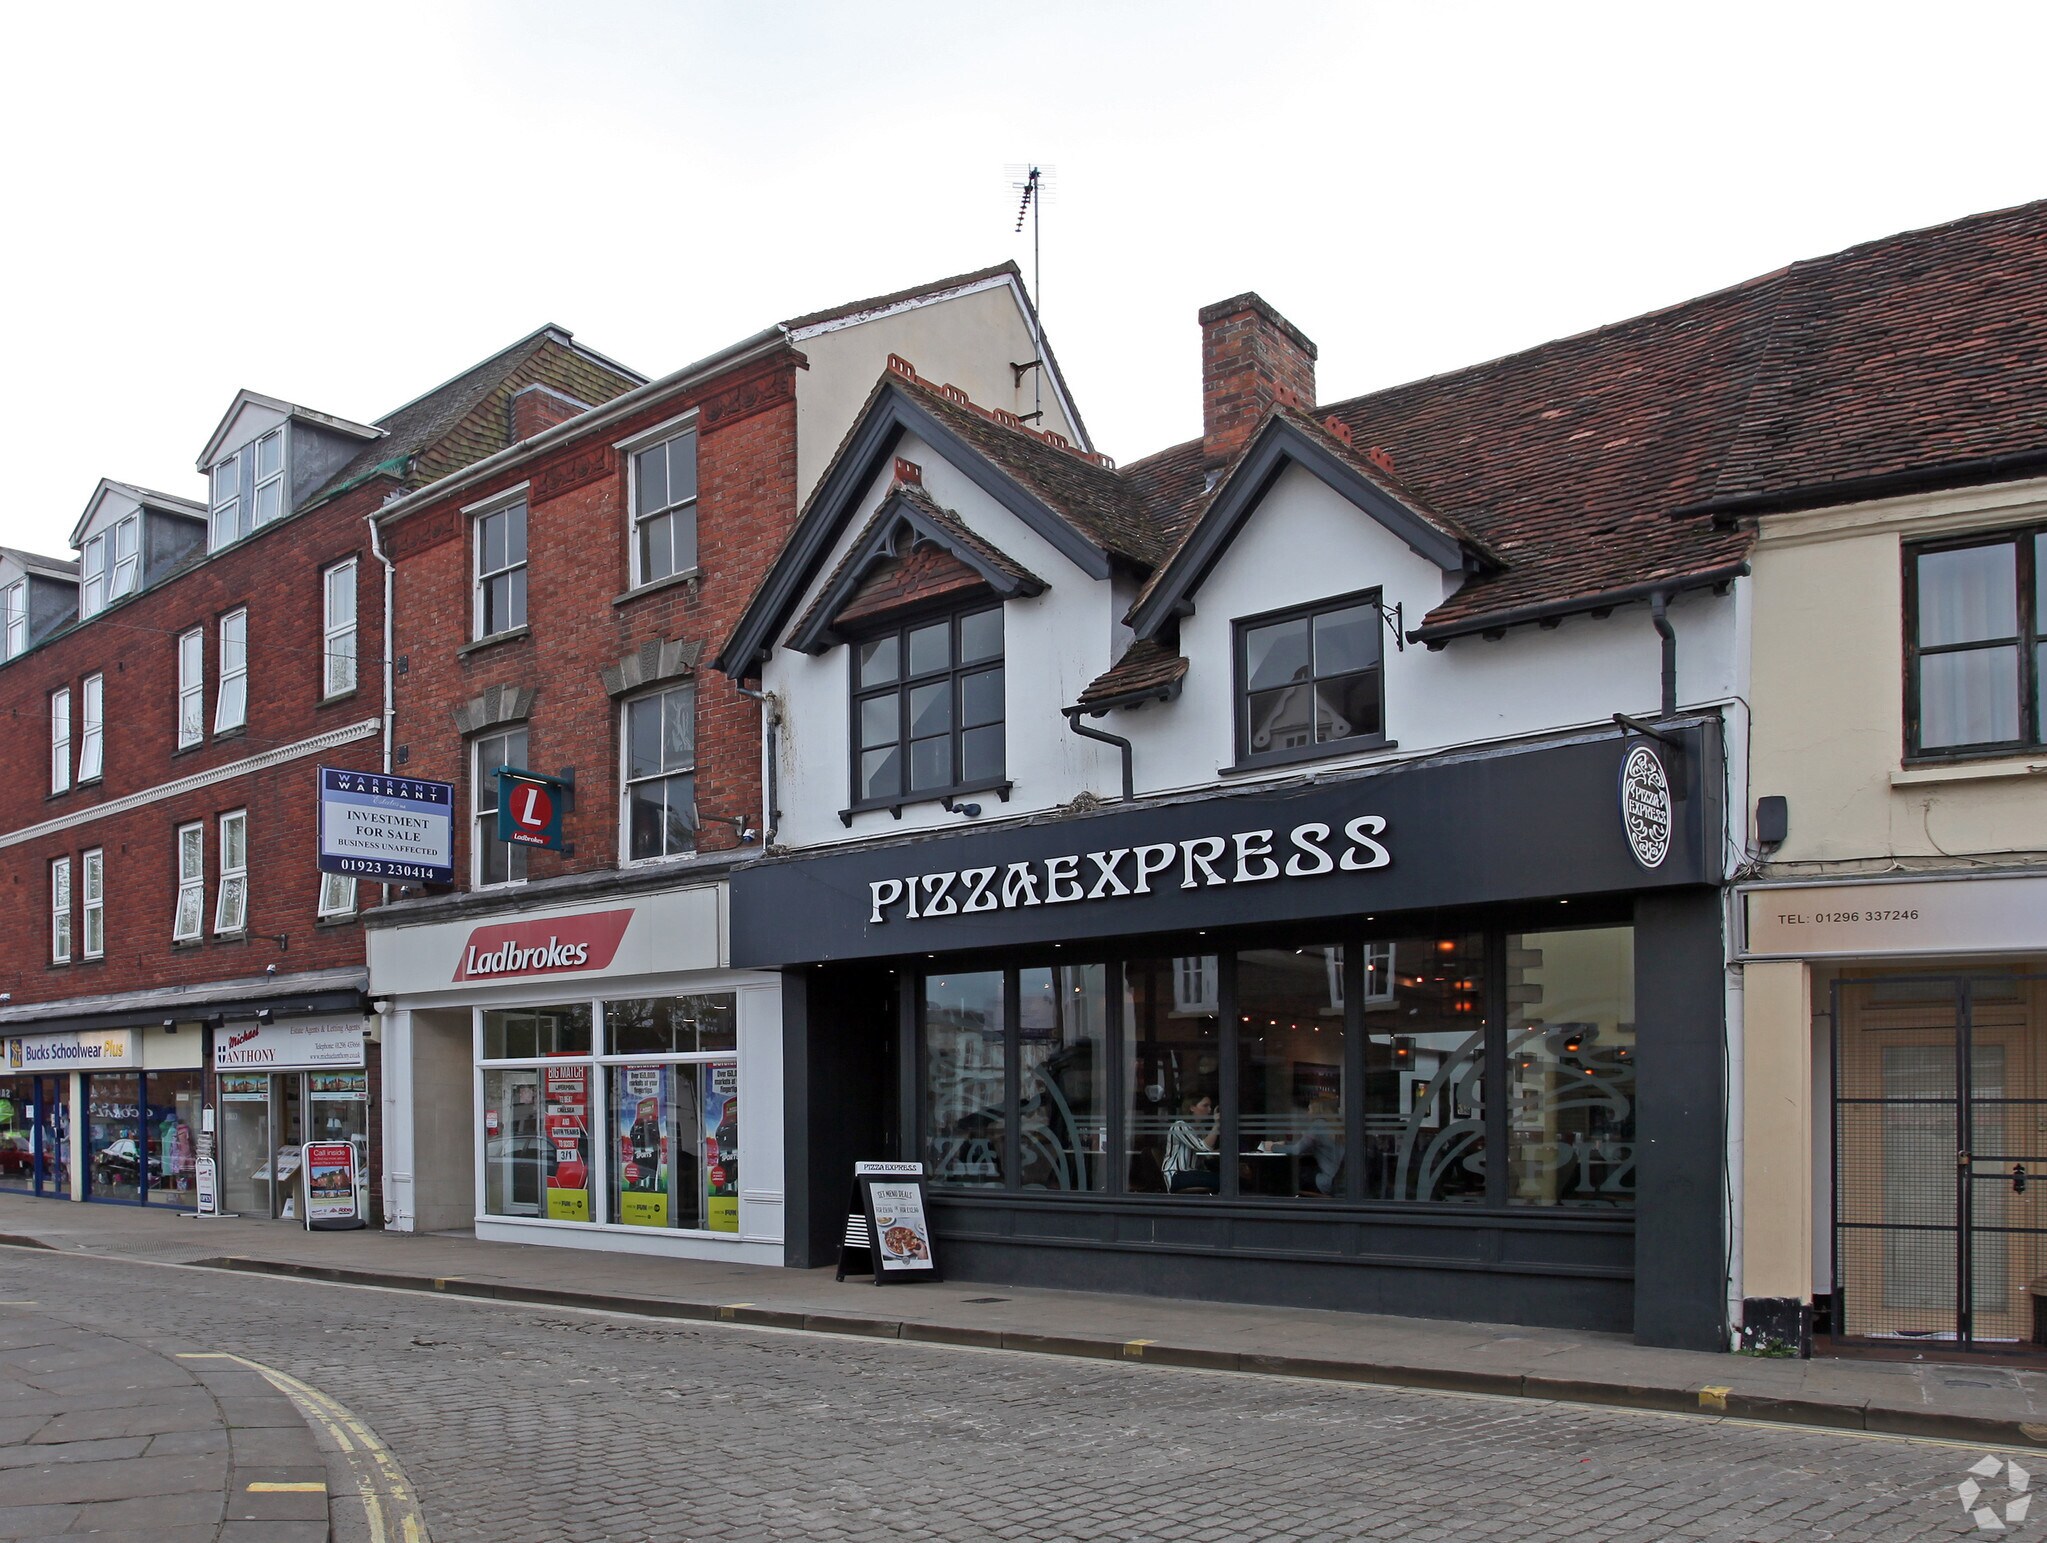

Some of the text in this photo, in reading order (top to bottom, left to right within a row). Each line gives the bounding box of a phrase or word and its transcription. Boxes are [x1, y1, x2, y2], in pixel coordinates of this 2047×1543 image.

[338, 774, 437, 793] WARRANT
[338, 782, 437, 801] WARRANT
[1636, 786, 1660, 808] PIZZA
[522, 788, 542, 825] L
[1629, 799, 1667, 825] EXPRESS
[347, 810, 430, 829] INVESTMENT
[356, 825, 421, 842] FOR SALE
[513, 833, 545, 844] Ladbrokes
[338, 838, 438, 856] BUSINESS UNAFFECTED
[341, 859, 434, 879] 01923 230414
[1778, 910, 1920, 925] TEL: 01296 337246
[466, 936, 589, 976] Ladbrokes
[228, 1024, 259, 1049] Michael
[290, 1026, 304, 1034] Estate
[305, 1026, 320, 1035] Agents
[326, 1024, 344, 1033] Letting
[344, 1023, 360, 1033] Agents
[26, 1039, 123, 1061] Bucks Schoolwear Plus
[226, 1048, 276, 1063] ANTHONY
[548, 1066, 583, 1079] BIG MATCH
[313, 1149, 326, 1157] Call
[560, 1151, 572, 1160] 3/1
[885, 1190, 898, 1198] MENU
[898, 1190, 912, 1199] DEALS
